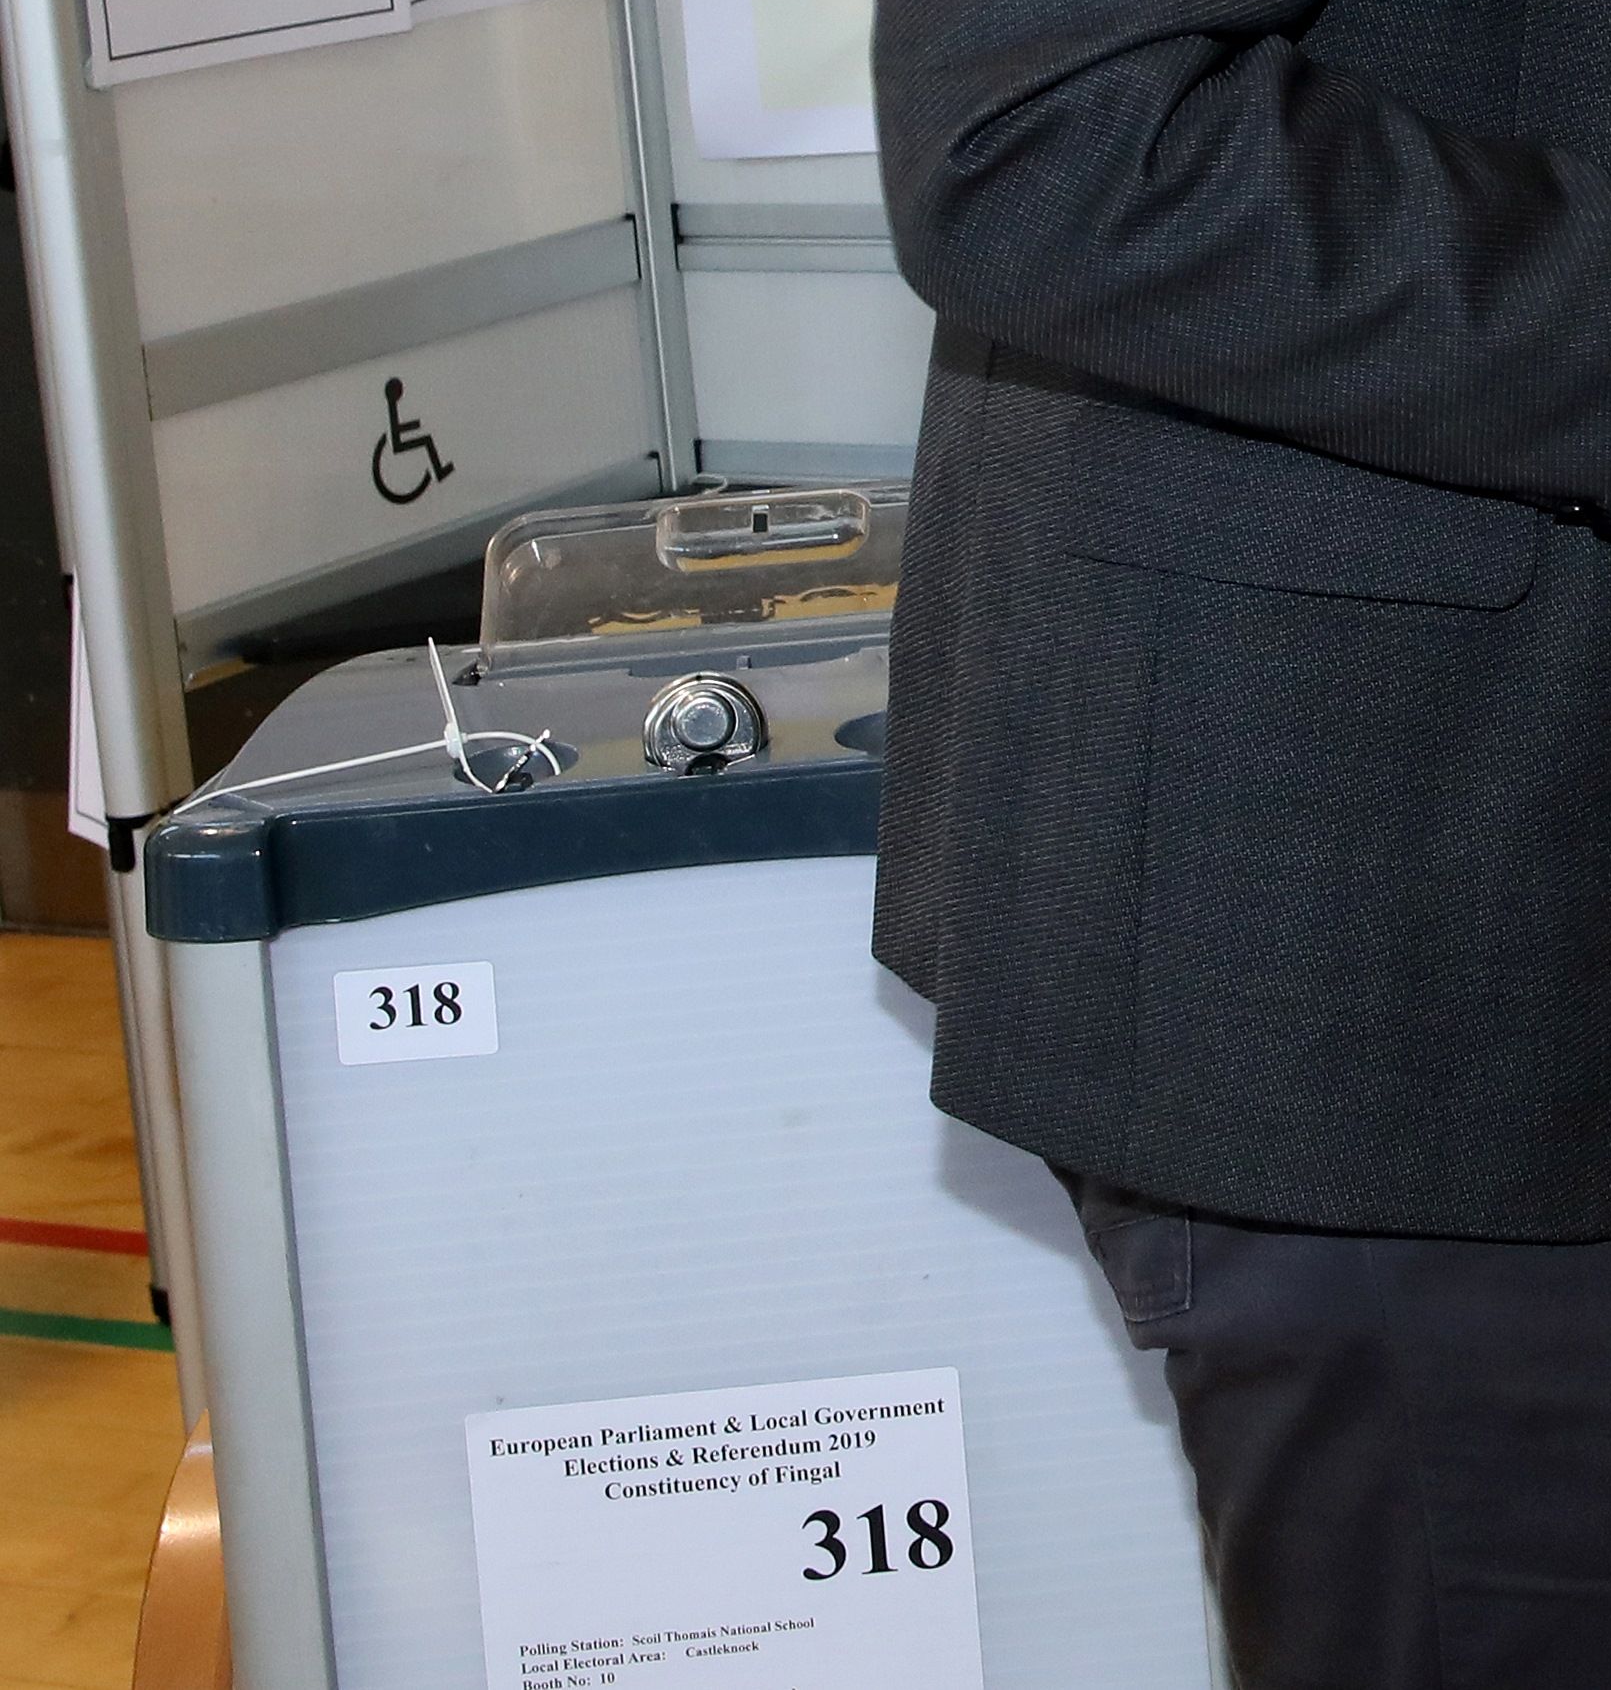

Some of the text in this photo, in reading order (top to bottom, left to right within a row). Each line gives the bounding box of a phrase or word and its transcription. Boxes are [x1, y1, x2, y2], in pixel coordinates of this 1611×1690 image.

[369, 980, 465, 1033] 318
[490, 1397, 946, 1457] European Parliament & Local Government
[564, 1429, 877, 1477] Elections & Referendum 2019
[604, 1461, 841, 1500] Constituency of Fingal
[801, 1499, 954, 1581] 318
[519, 1617, 815, 1658] Polling Station: Scoil Thomais National School
[521, 1641, 760, 1675] Local Electoral Area: Castleknock
[522, 1672, 616, 1690] Booth No: 10
